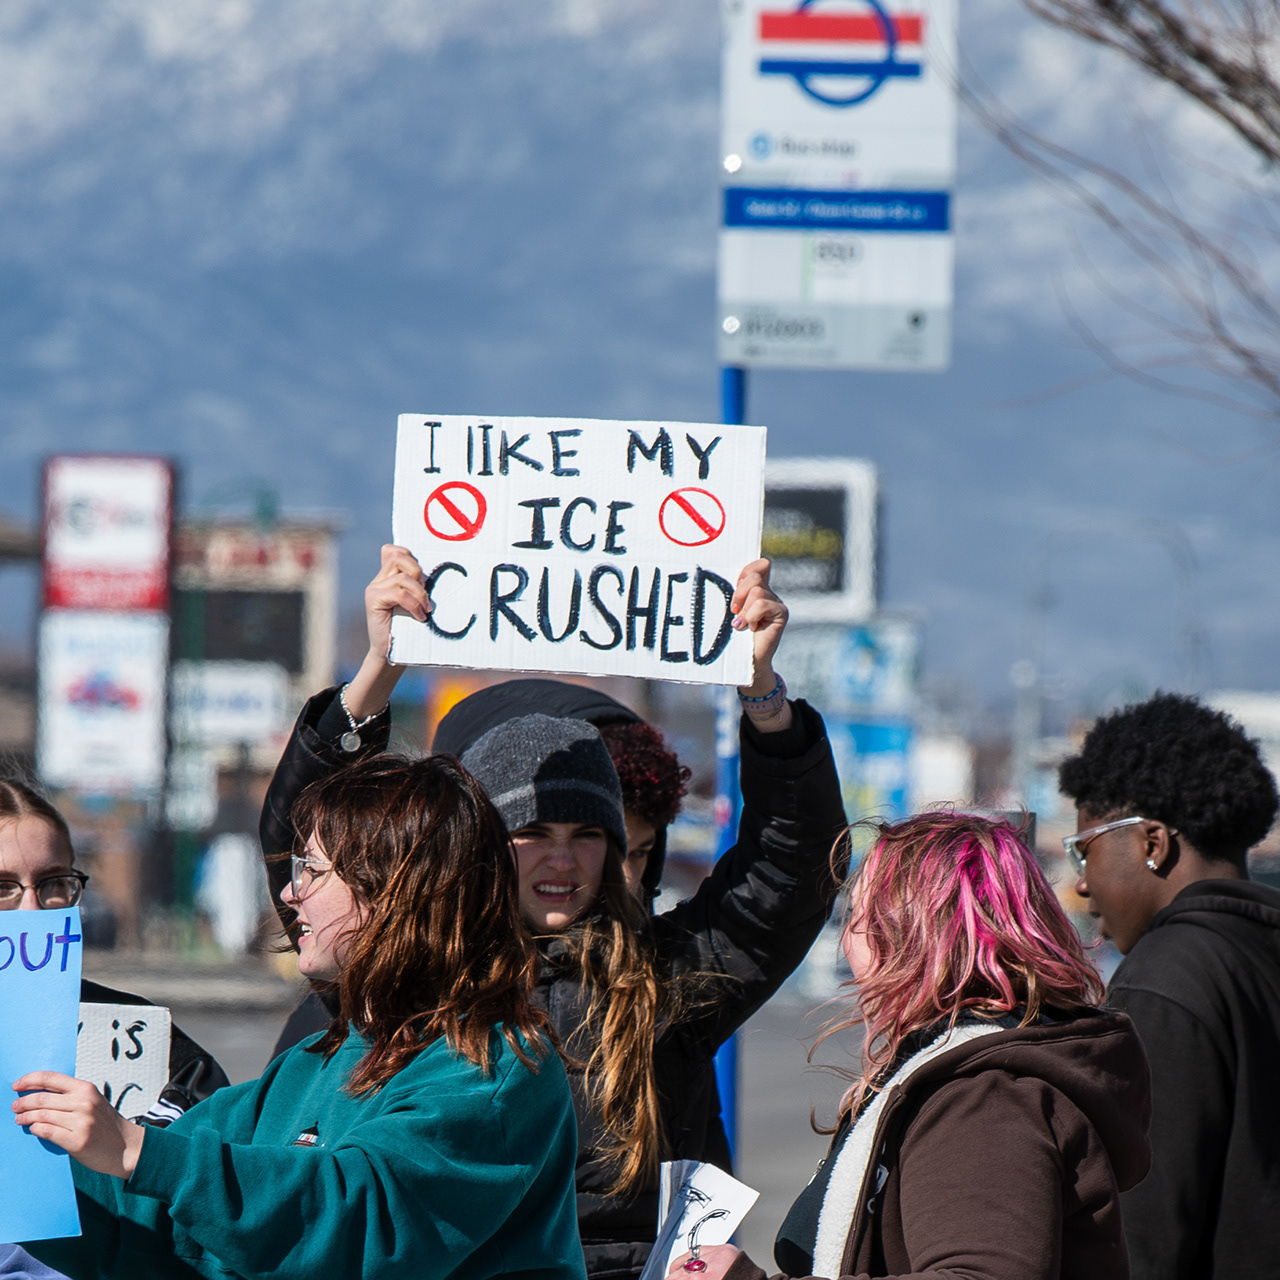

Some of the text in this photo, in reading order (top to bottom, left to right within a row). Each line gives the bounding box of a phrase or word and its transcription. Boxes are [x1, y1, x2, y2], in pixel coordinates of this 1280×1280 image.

[424, 421, 442, 474] I
[627, 427, 722, 480] MY
[512, 496, 635, 555] ICE
[424, 561, 736, 666] CRUSHED
